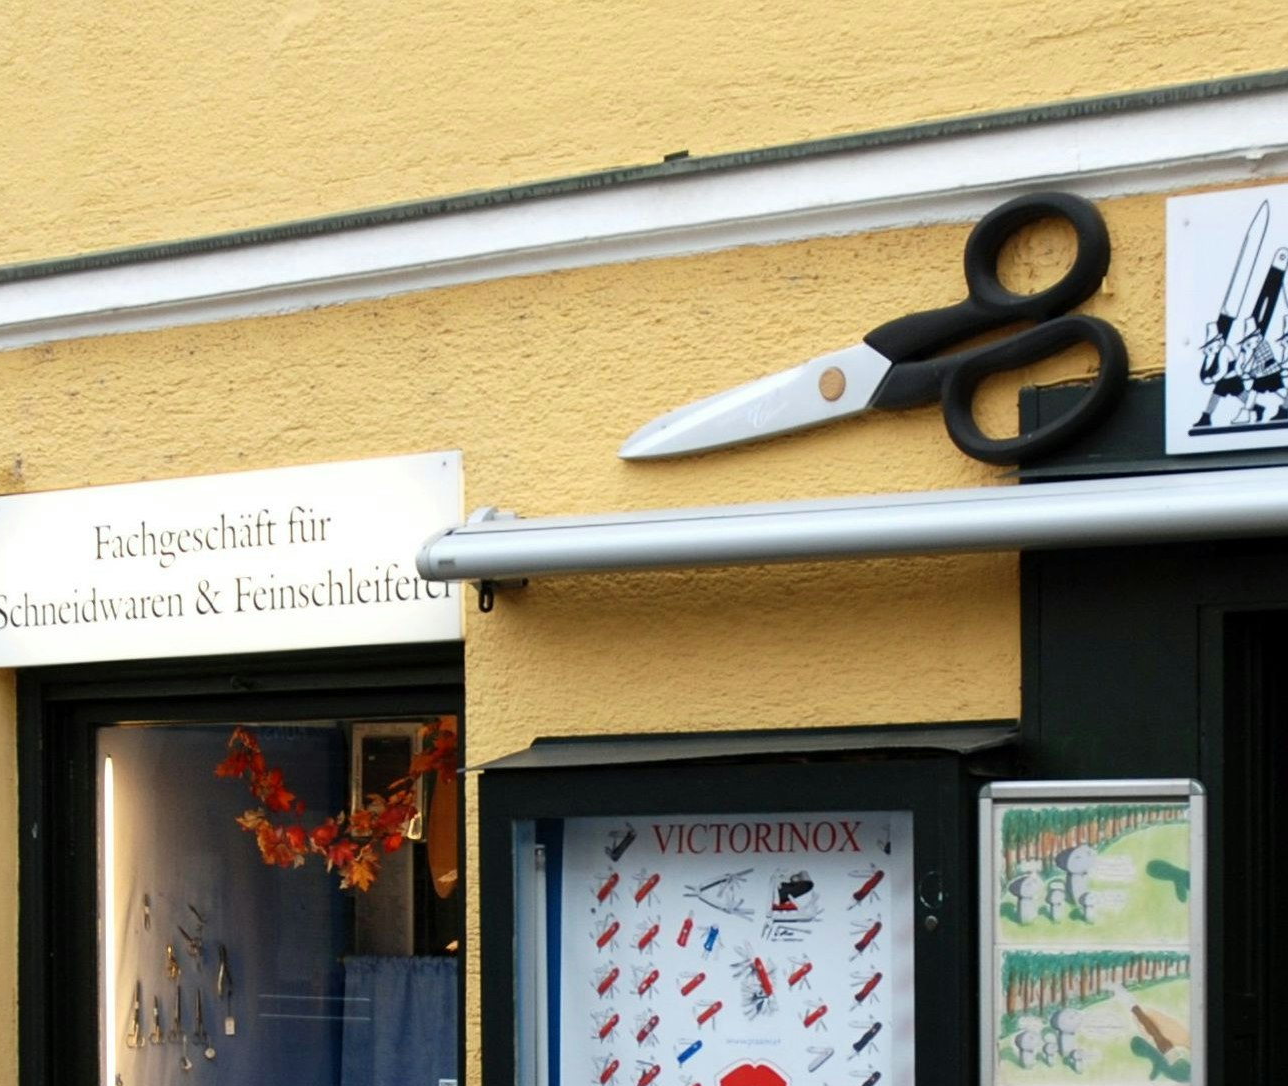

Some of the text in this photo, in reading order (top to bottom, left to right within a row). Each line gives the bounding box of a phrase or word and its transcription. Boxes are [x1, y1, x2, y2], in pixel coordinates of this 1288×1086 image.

[95, 506, 332, 569] Fachgeschäft für
[196, 579, 222, 615] &
[654, 821, 863, 855] VICTORINOX
